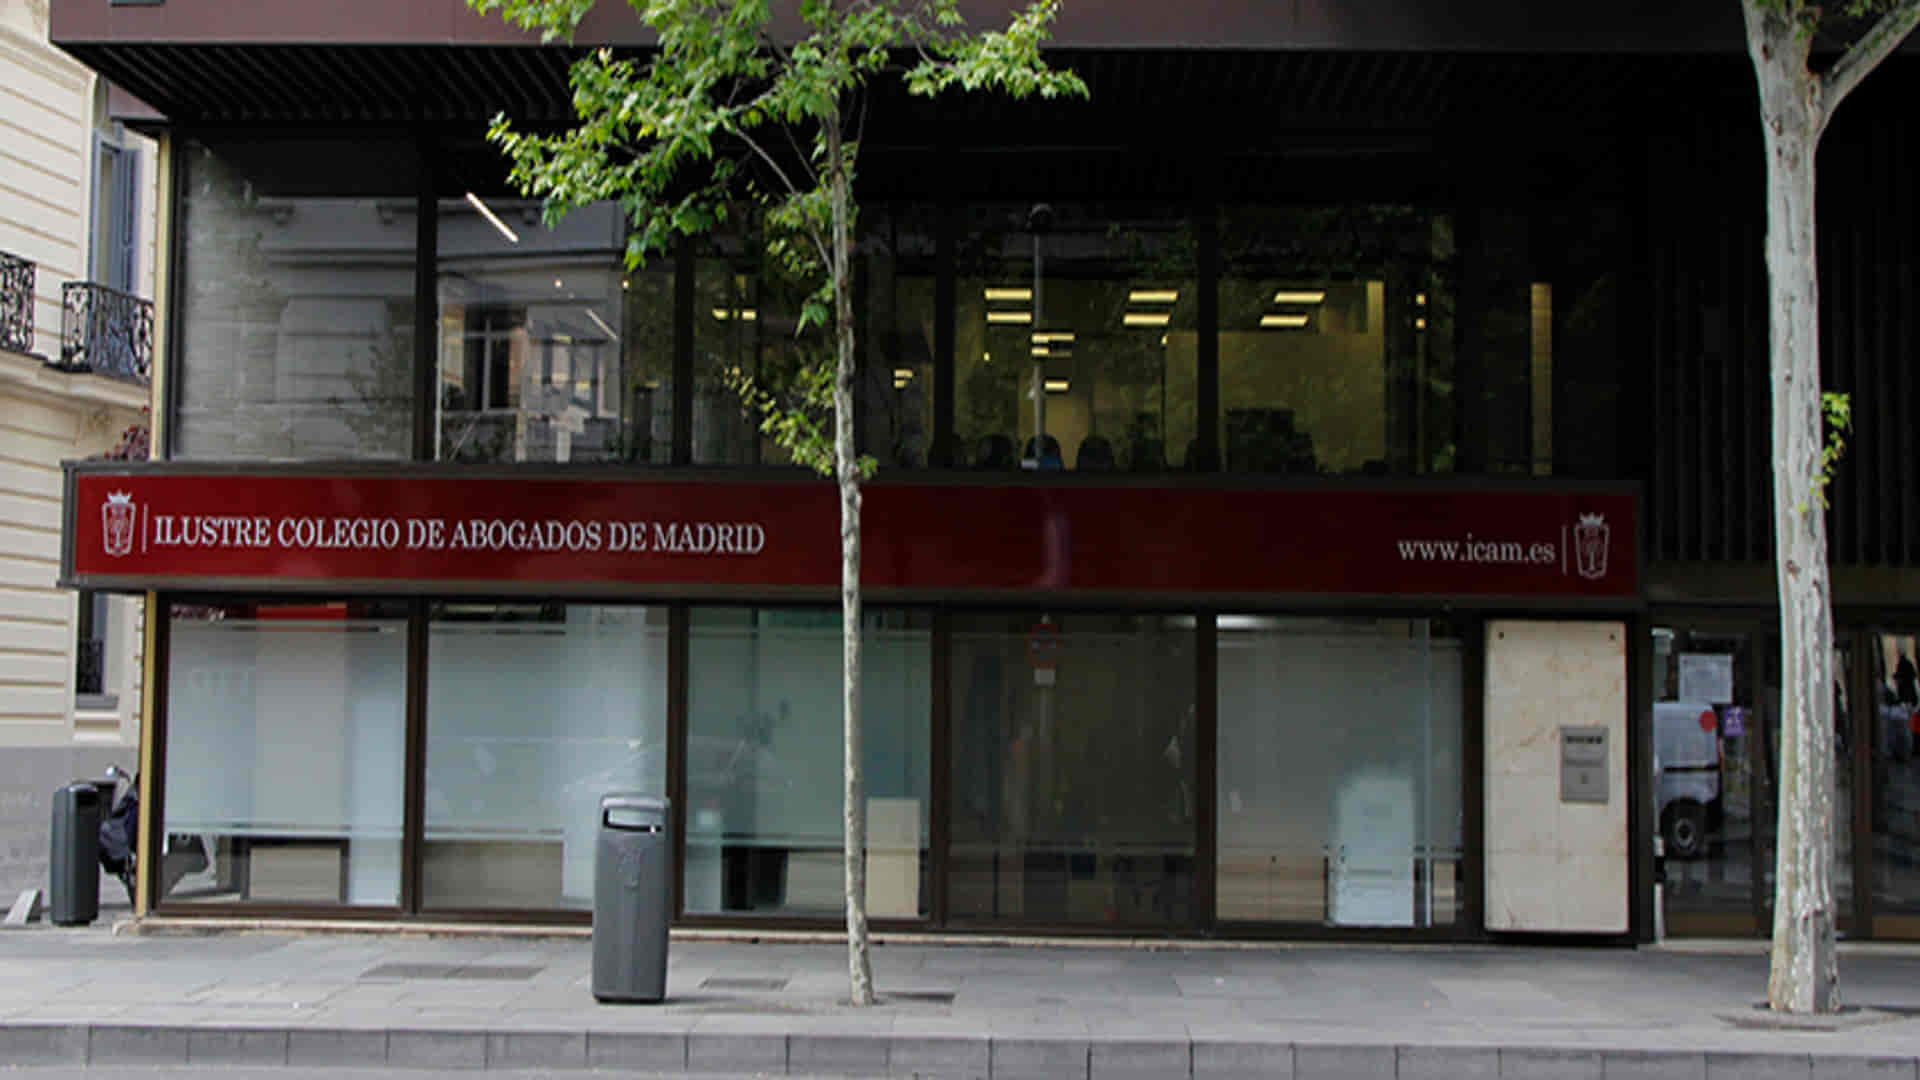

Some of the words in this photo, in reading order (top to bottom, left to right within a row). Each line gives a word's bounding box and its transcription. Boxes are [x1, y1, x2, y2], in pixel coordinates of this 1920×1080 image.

[154, 515, 271, 546] ILUSTRE
[276, 517, 400, 548] COLEGIO
[407, 519, 445, 548] DE
[450, 520, 601, 551] ABOGADOS
[608, 522, 647, 552] DE
[652, 522, 765, 553] MADRID
[1397, 533, 1556, 563] www.icam.es
